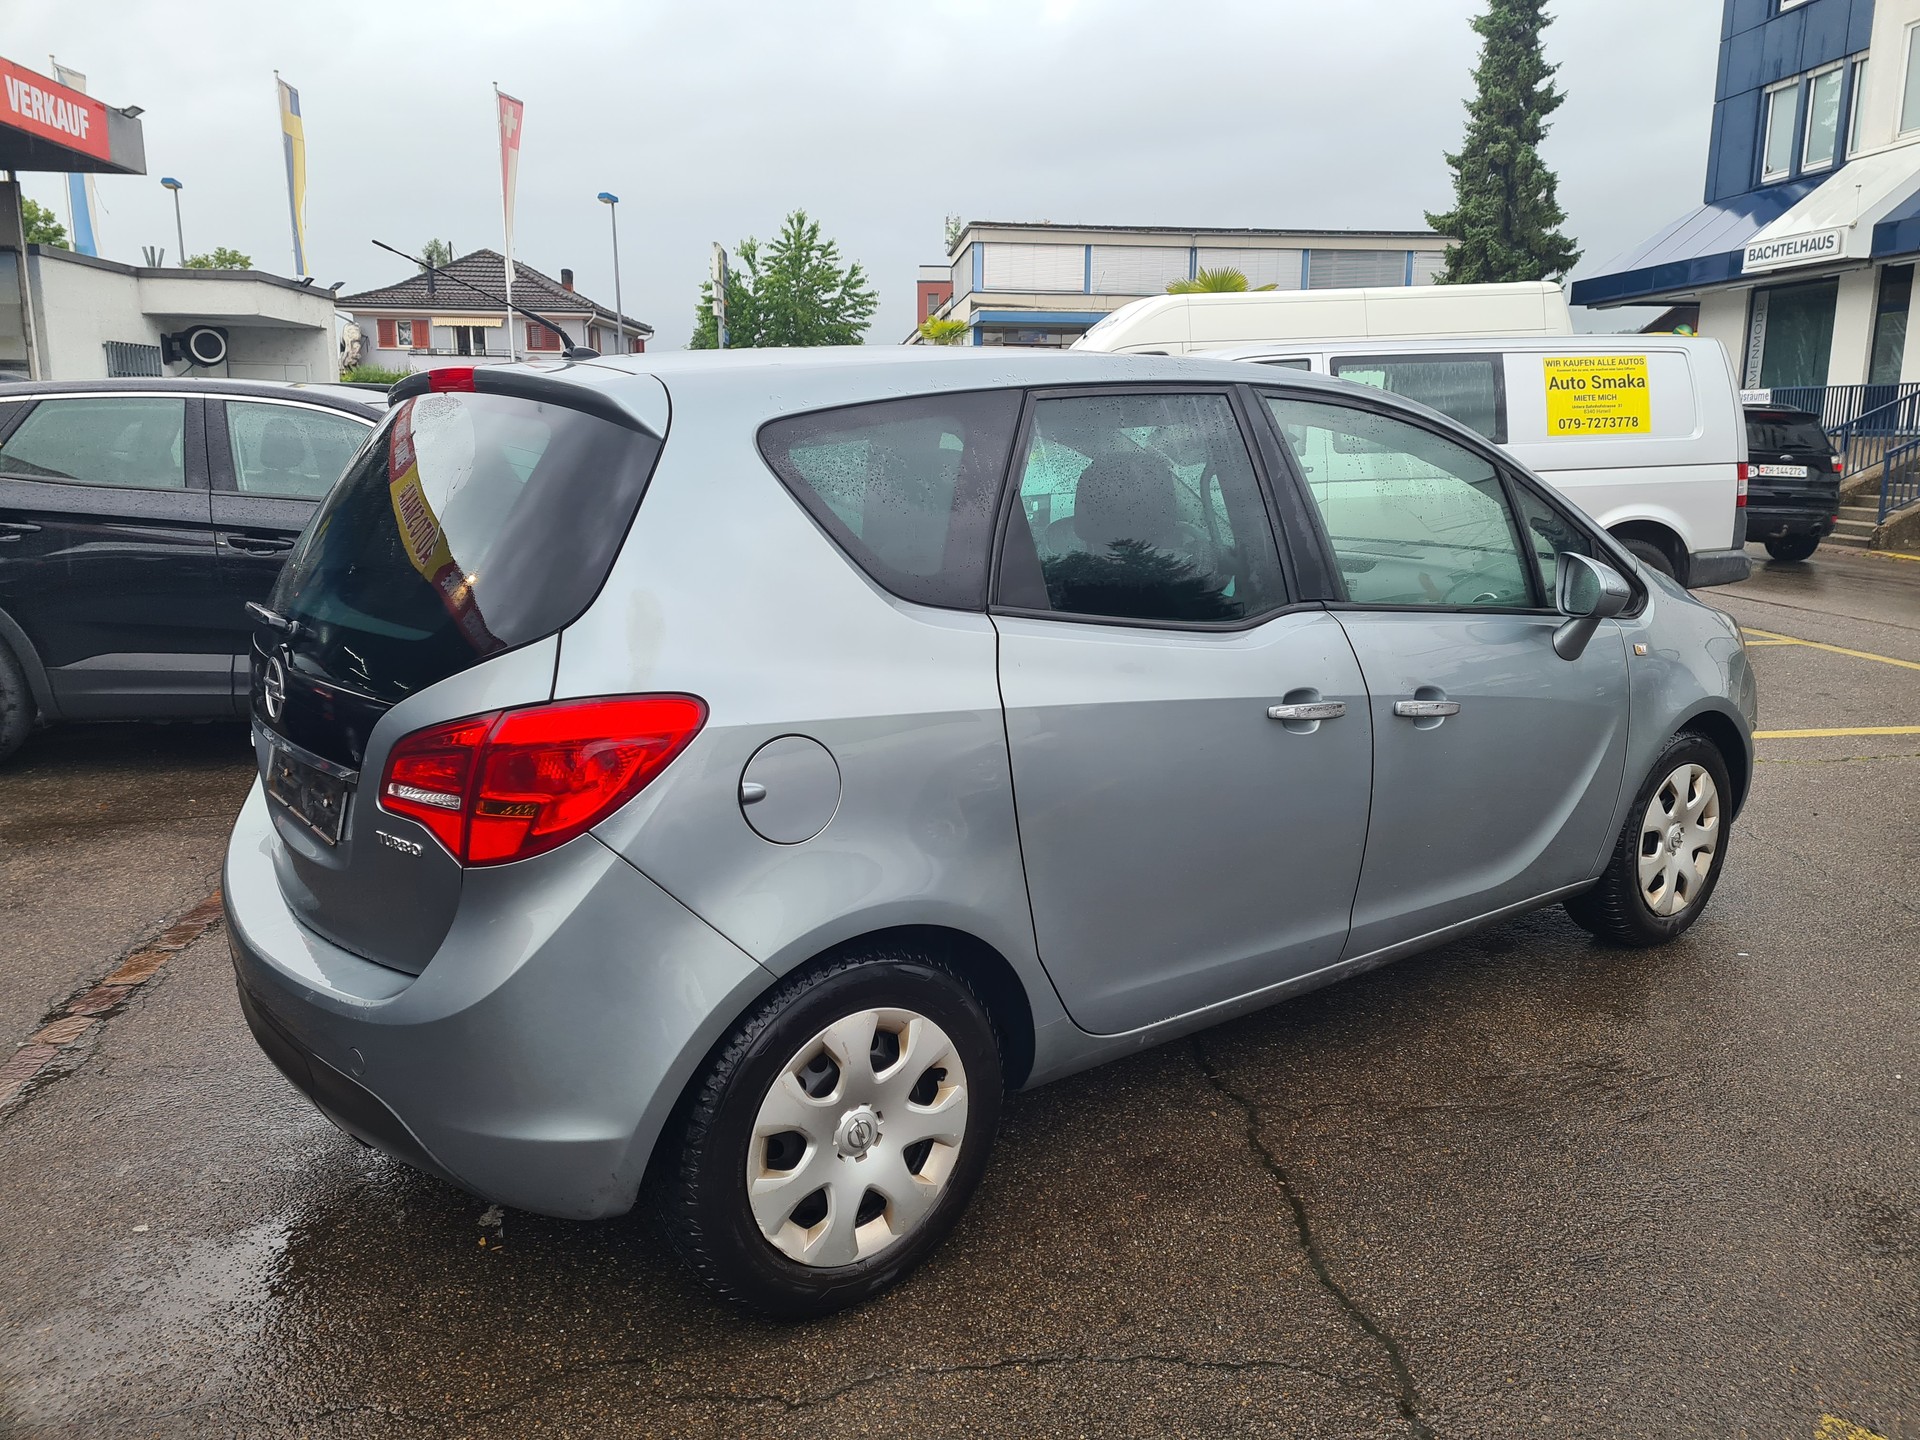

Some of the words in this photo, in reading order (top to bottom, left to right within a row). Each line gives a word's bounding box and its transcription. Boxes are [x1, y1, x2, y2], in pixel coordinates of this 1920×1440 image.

[4, 74, 90, 140] VERKAUF
[1748, 234, 1834, 262] BACHTELHAUS
[1749, 303, 1766, 389] AMENMODE
[1563, 359, 1595, 367] KAUFEN
[1597, 358, 1616, 366] ALLE
[1618, 358, 1645, 366] AUTOS
[1549, 376, 1586, 390] Auto
[1591, 373, 1646, 389] Smaka
[1573, 394, 1596, 402] MIETE
[1558, 416, 1639, 430] 079-7273778
[375, 830, 423, 857] TURBO
